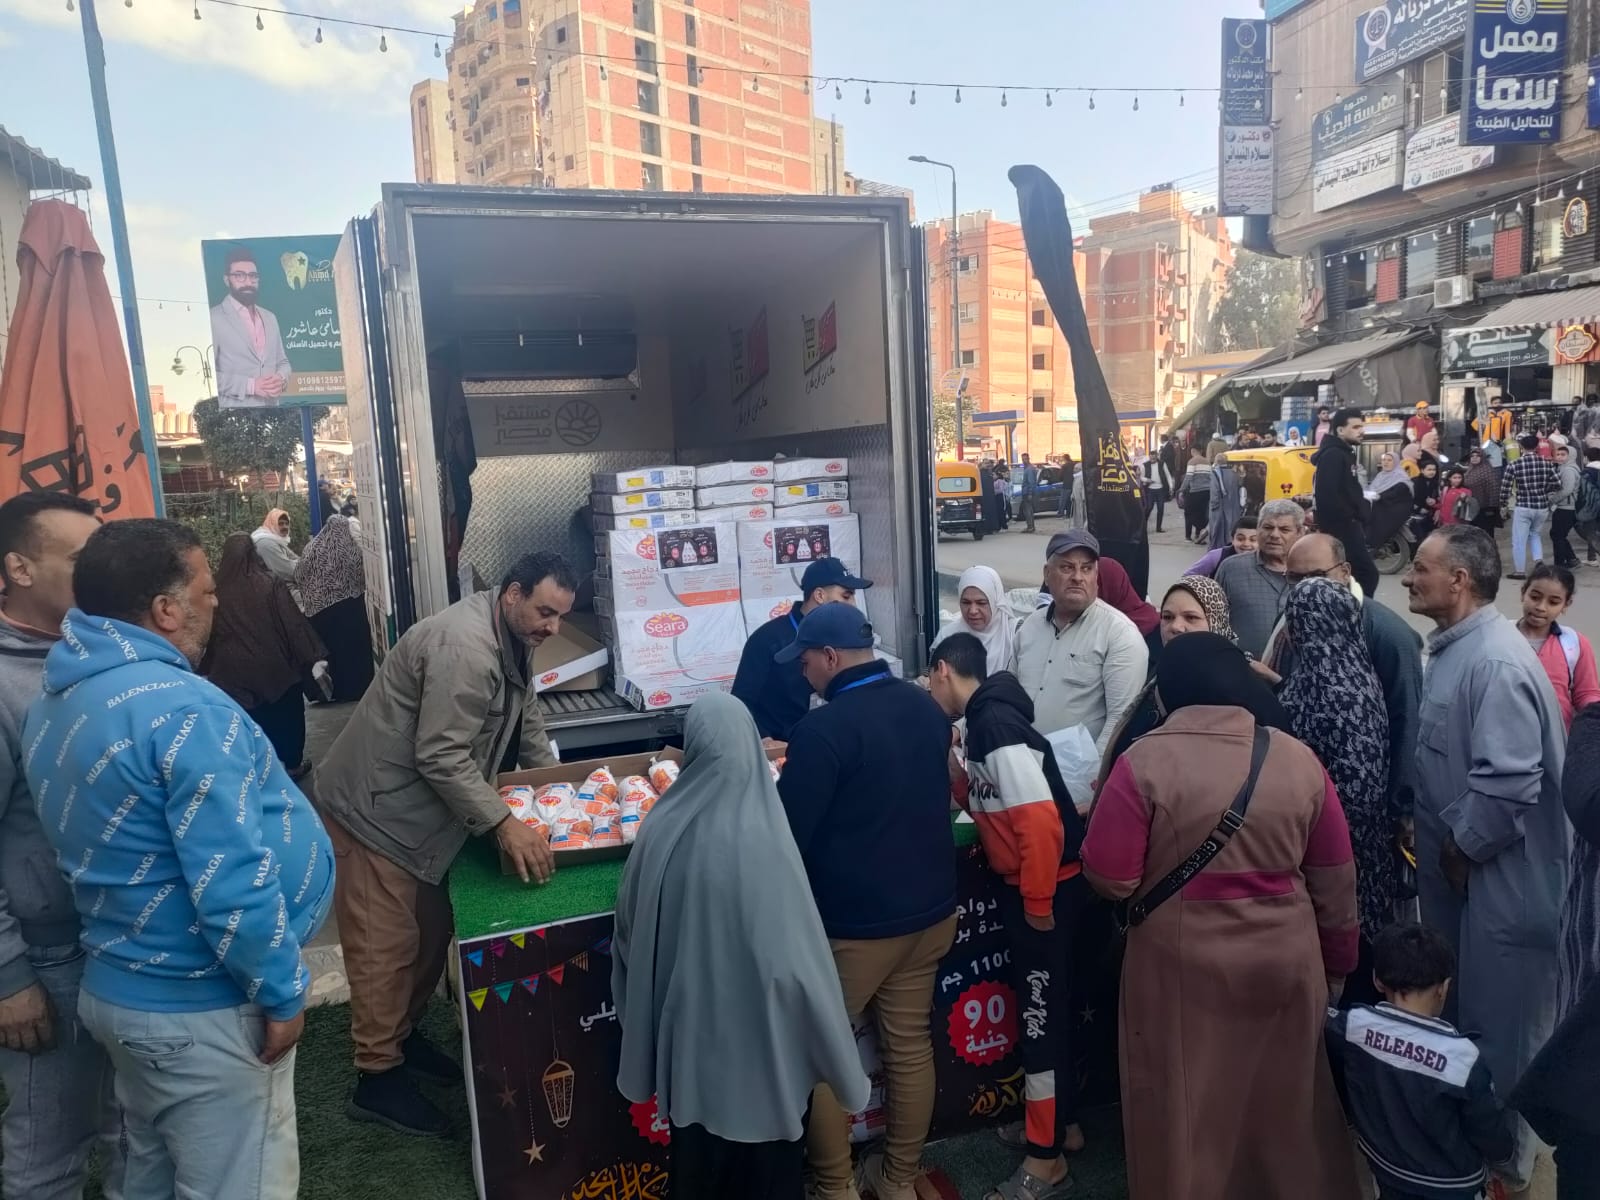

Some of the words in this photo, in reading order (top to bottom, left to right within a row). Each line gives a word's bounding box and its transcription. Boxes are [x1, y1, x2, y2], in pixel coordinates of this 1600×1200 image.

[1480, 25, 1558, 59] معمل
[1476, 65, 1558, 109] سما
[1475, 115, 1510, 132] الطبية
[1511, 115, 1553, 131] للتحاليل
[286, 319, 318, 339] عاشور
[645, 621, 686, 634] Seara
[105, 680, 186, 709] BALENCIAGA
[175, 772, 216, 841] BALENCIAGA
[189, 853, 226, 908] ENCIAGA
[253, 847, 272, 887] BALEN
[294, 841, 318, 904] BALENCIAGA
[963, 994, 1006, 1029] 90
[1022, 1006, 1048, 1040] Kids
[1364, 1028, 1448, 1073] RELEASED
